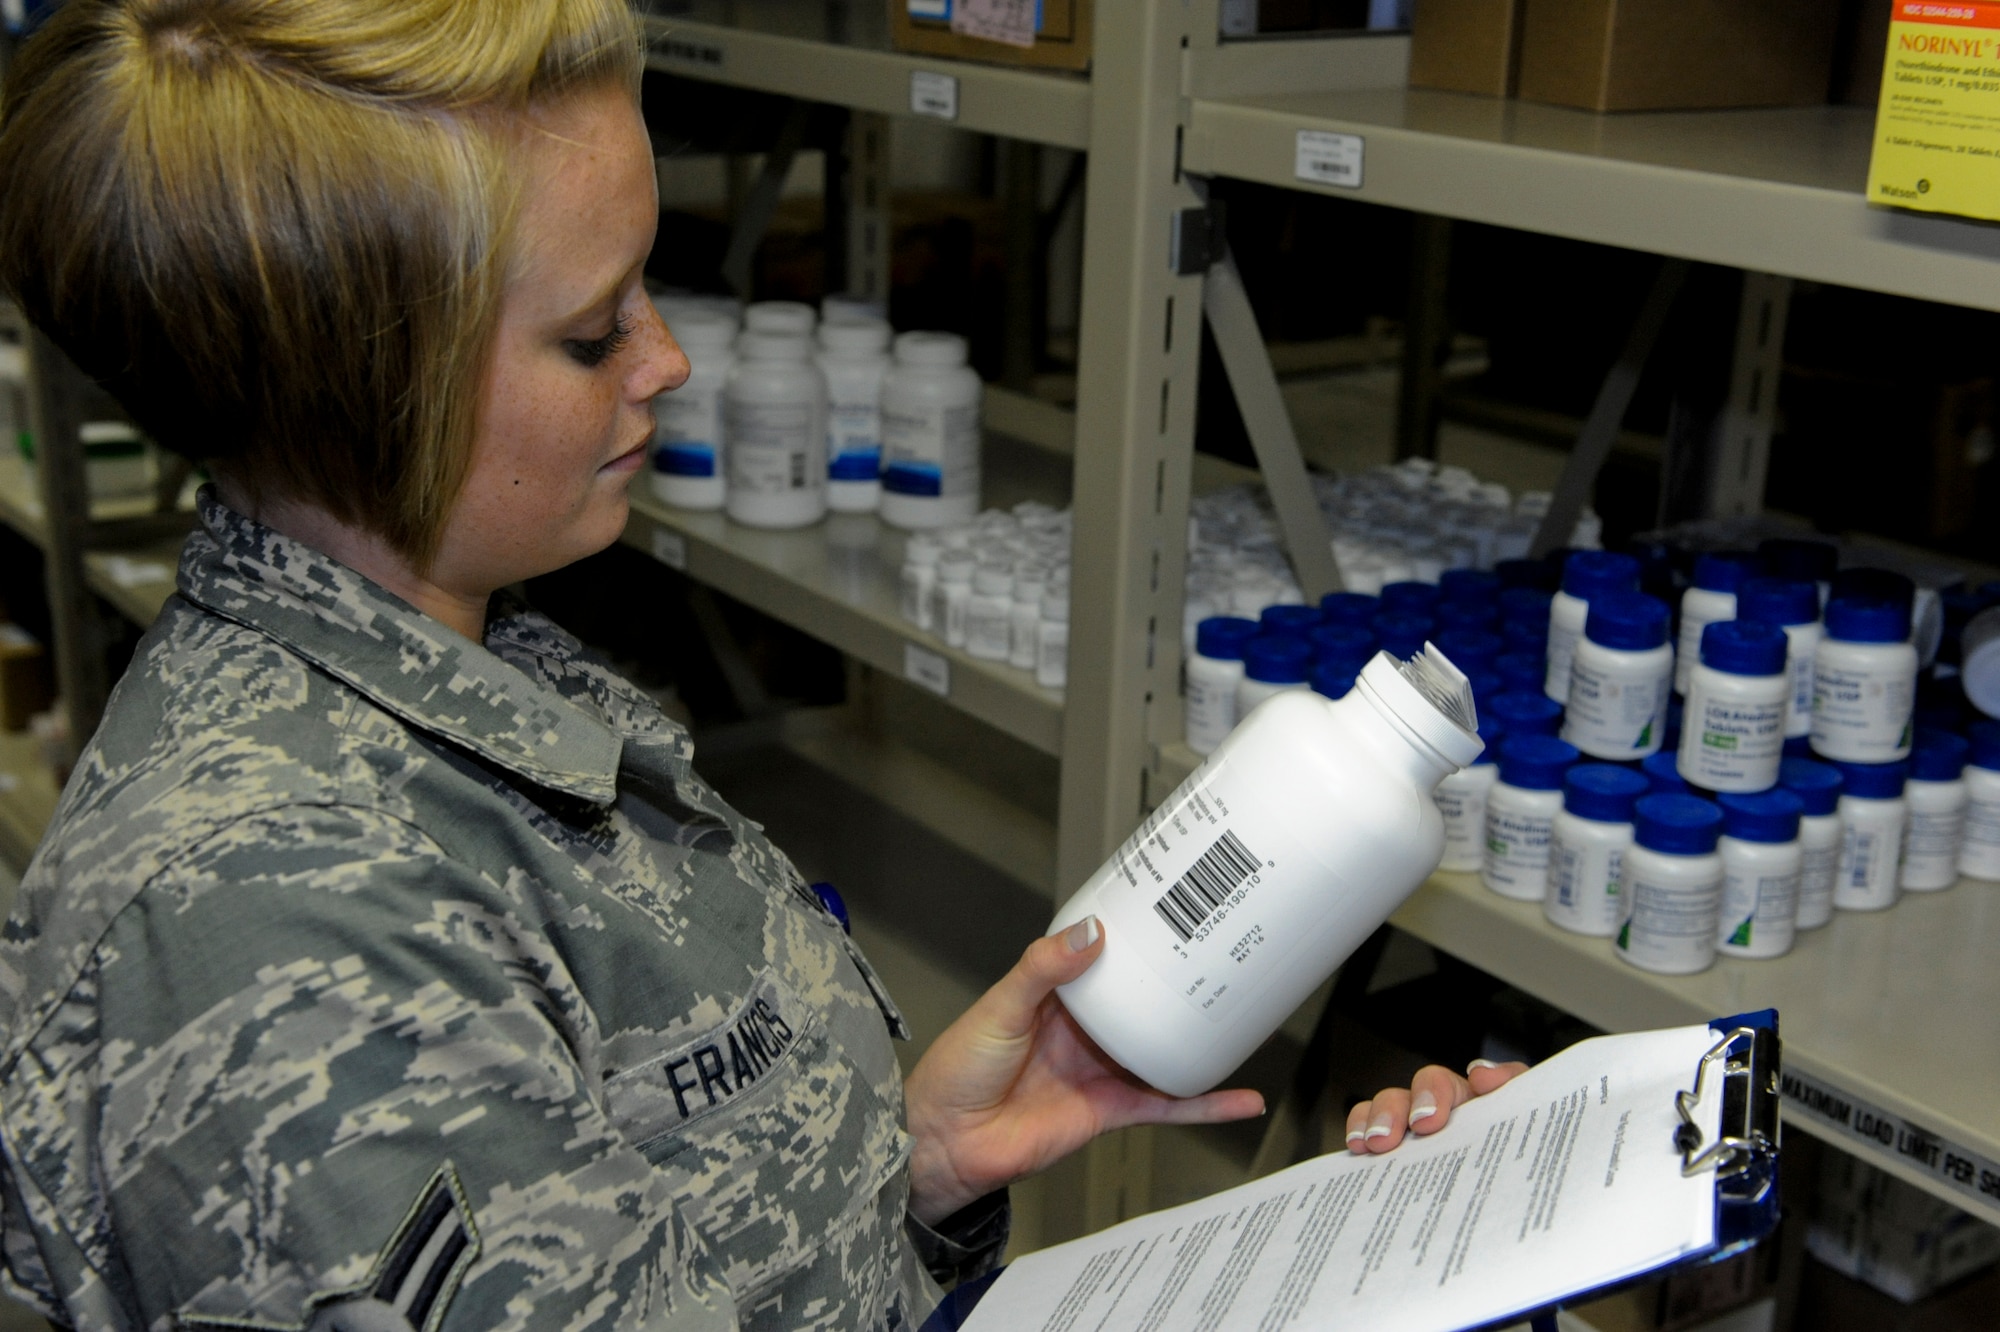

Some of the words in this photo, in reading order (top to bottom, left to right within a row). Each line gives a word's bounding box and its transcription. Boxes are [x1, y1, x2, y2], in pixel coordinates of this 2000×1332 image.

[1181, 951, 1188, 960] 3
[1194, 874, 1262, 943] 53746-190-10
[1267, 860, 1276, 869] 9
[1229, 924, 1263, 959] HE32712
[1236, 947, 1252, 964] MAY
[1253, 934, 1265, 948] 16
[663, 997, 793, 1119] FRANCIS
[1782, 1074, 1851, 1124] MAXIMUM
[1855, 1108, 1894, 1146] LOAD
[1897, 1129, 1942, 1169] LIMIT
[1943, 1152, 1975, 1187] PER
